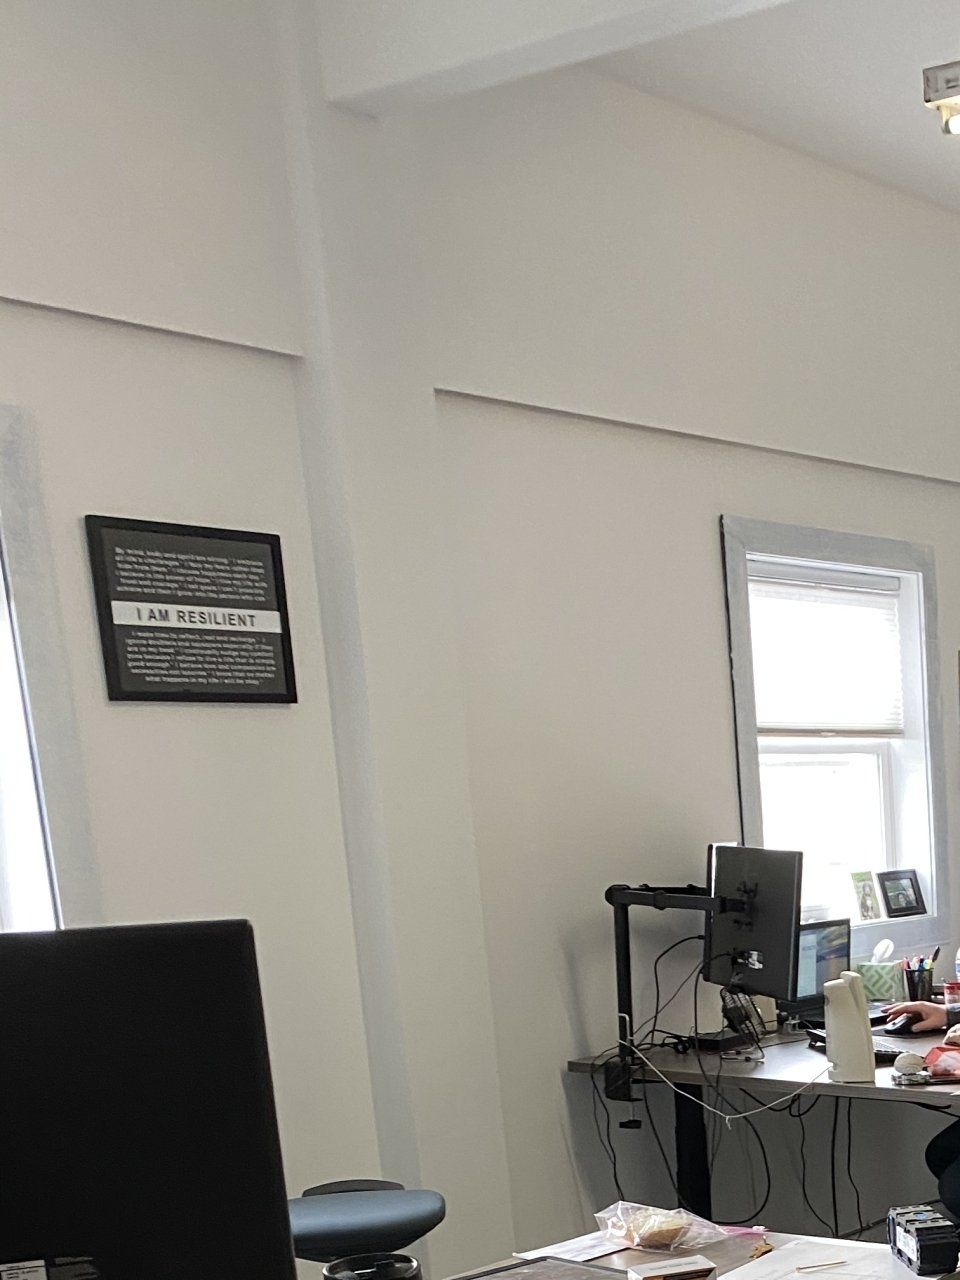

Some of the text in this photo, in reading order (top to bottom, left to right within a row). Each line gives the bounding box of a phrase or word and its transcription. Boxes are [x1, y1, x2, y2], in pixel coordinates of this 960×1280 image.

[136, 607, 256, 627] I AM RESILIENT
